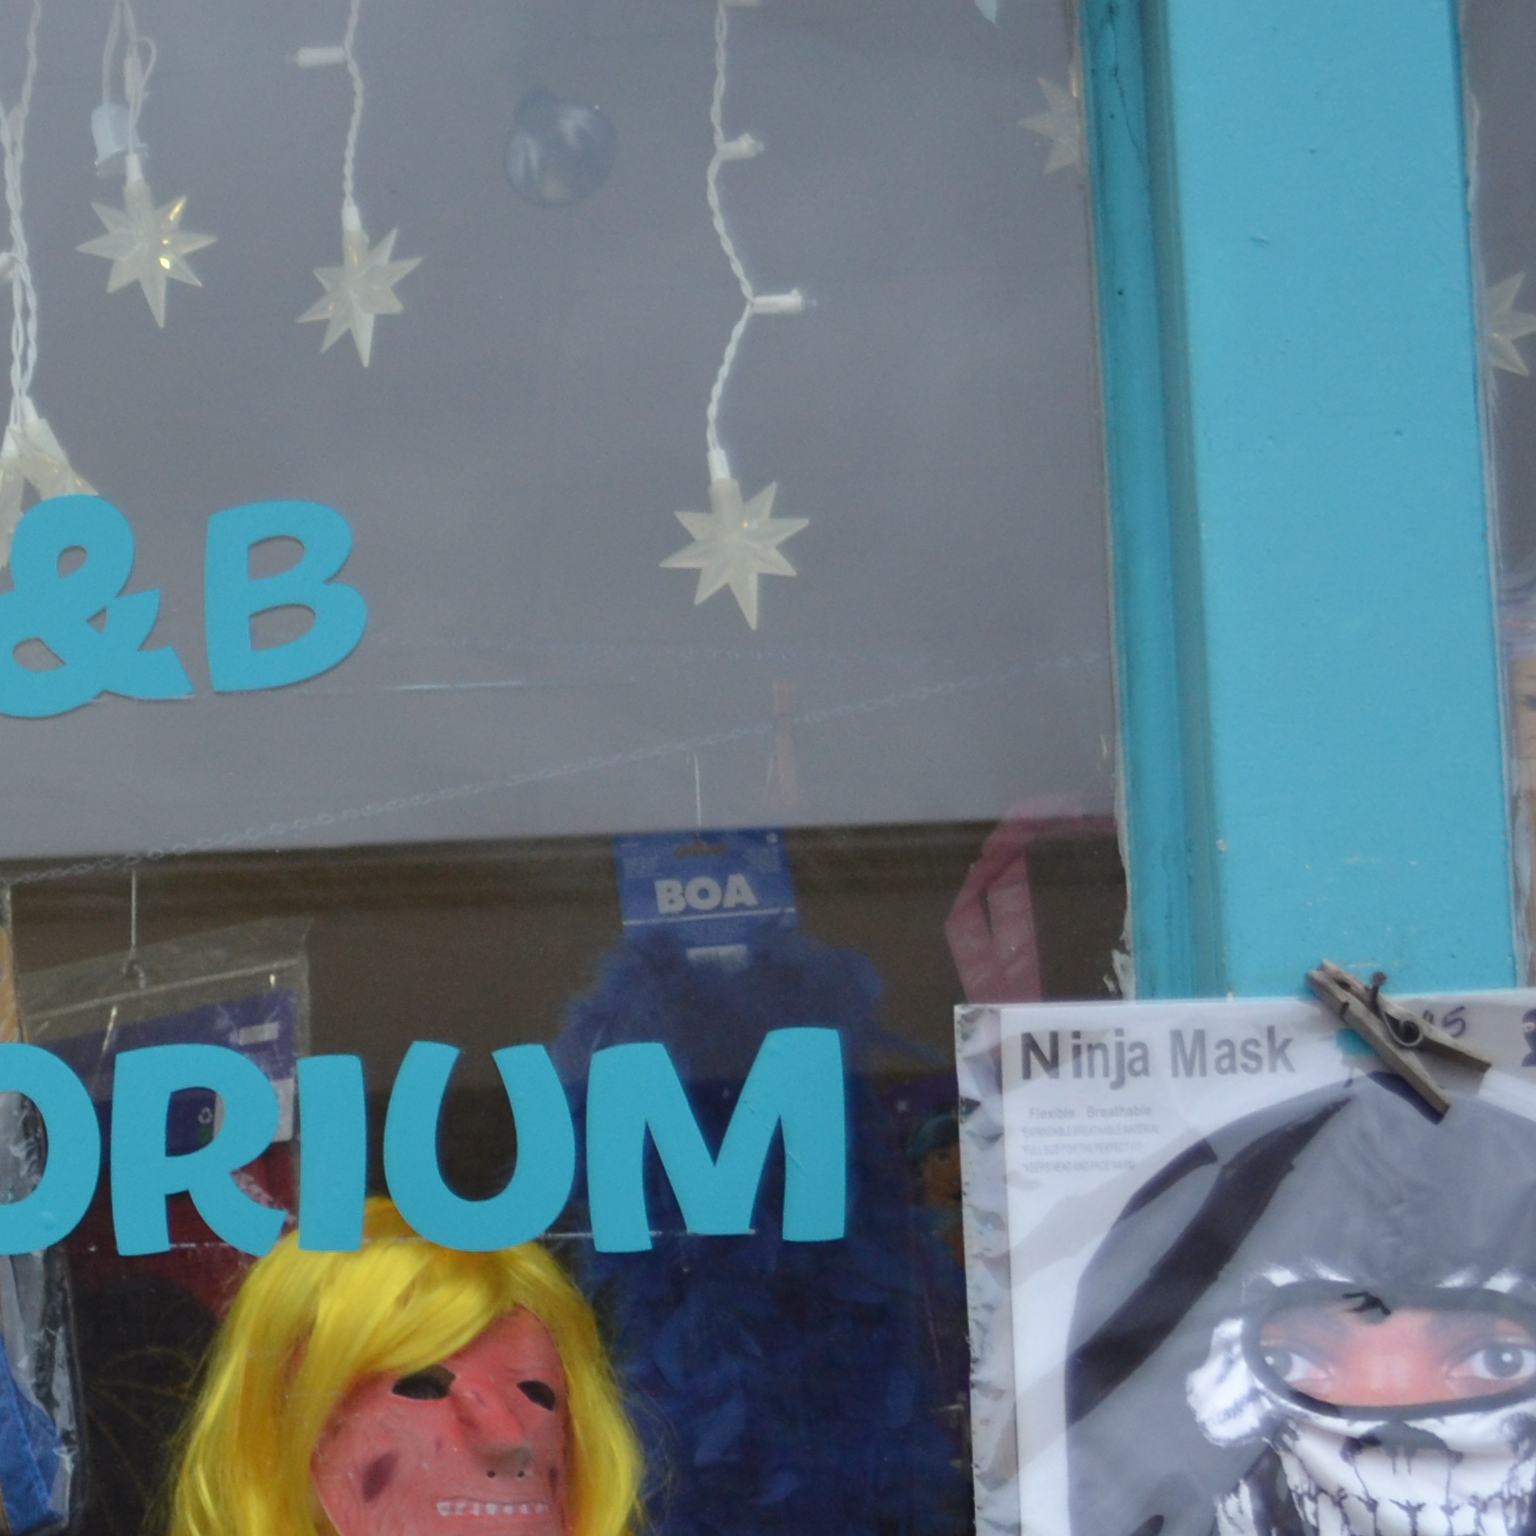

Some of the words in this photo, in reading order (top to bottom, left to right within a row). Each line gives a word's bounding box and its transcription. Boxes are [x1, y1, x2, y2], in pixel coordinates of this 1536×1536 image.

[654, 872, 759, 914] BOA
[1021, 1028, 1150, 1090] Ninja
[1170, 1024, 1296, 1079] Mask
